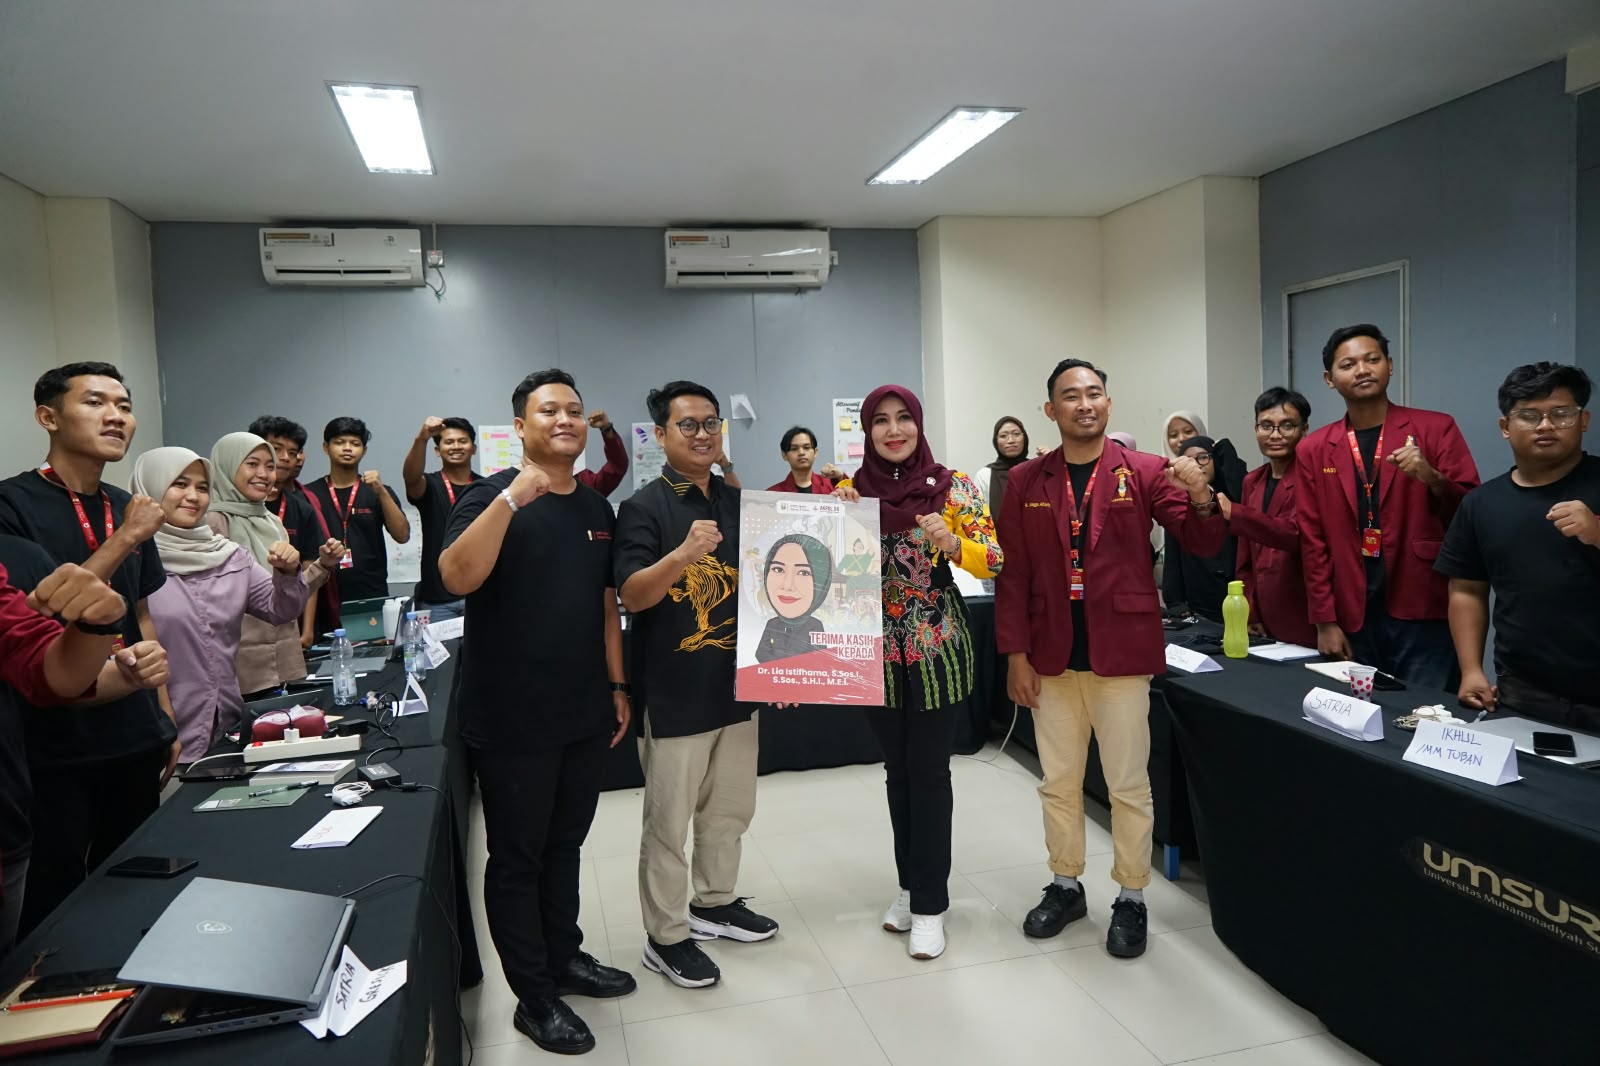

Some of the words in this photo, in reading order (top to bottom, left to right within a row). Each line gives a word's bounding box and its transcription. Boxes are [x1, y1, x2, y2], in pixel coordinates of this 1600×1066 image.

[810, 632, 844, 645] TERIMA
[846, 634, 874, 646] KASIH
[838, 647, 874, 659] KEPADA
[757, 667, 770, 675] Dr.
[771, 667, 784, 675] Lia
[1309, 691, 1352, 717] SATRIA
[1447, 748, 1483, 767] TUBAN
[1423, 867, 1482, 899] Universitas
[1484, 893, 1584, 945] Muhammadiyah
[335, 962, 355, 1010] SATRIA
